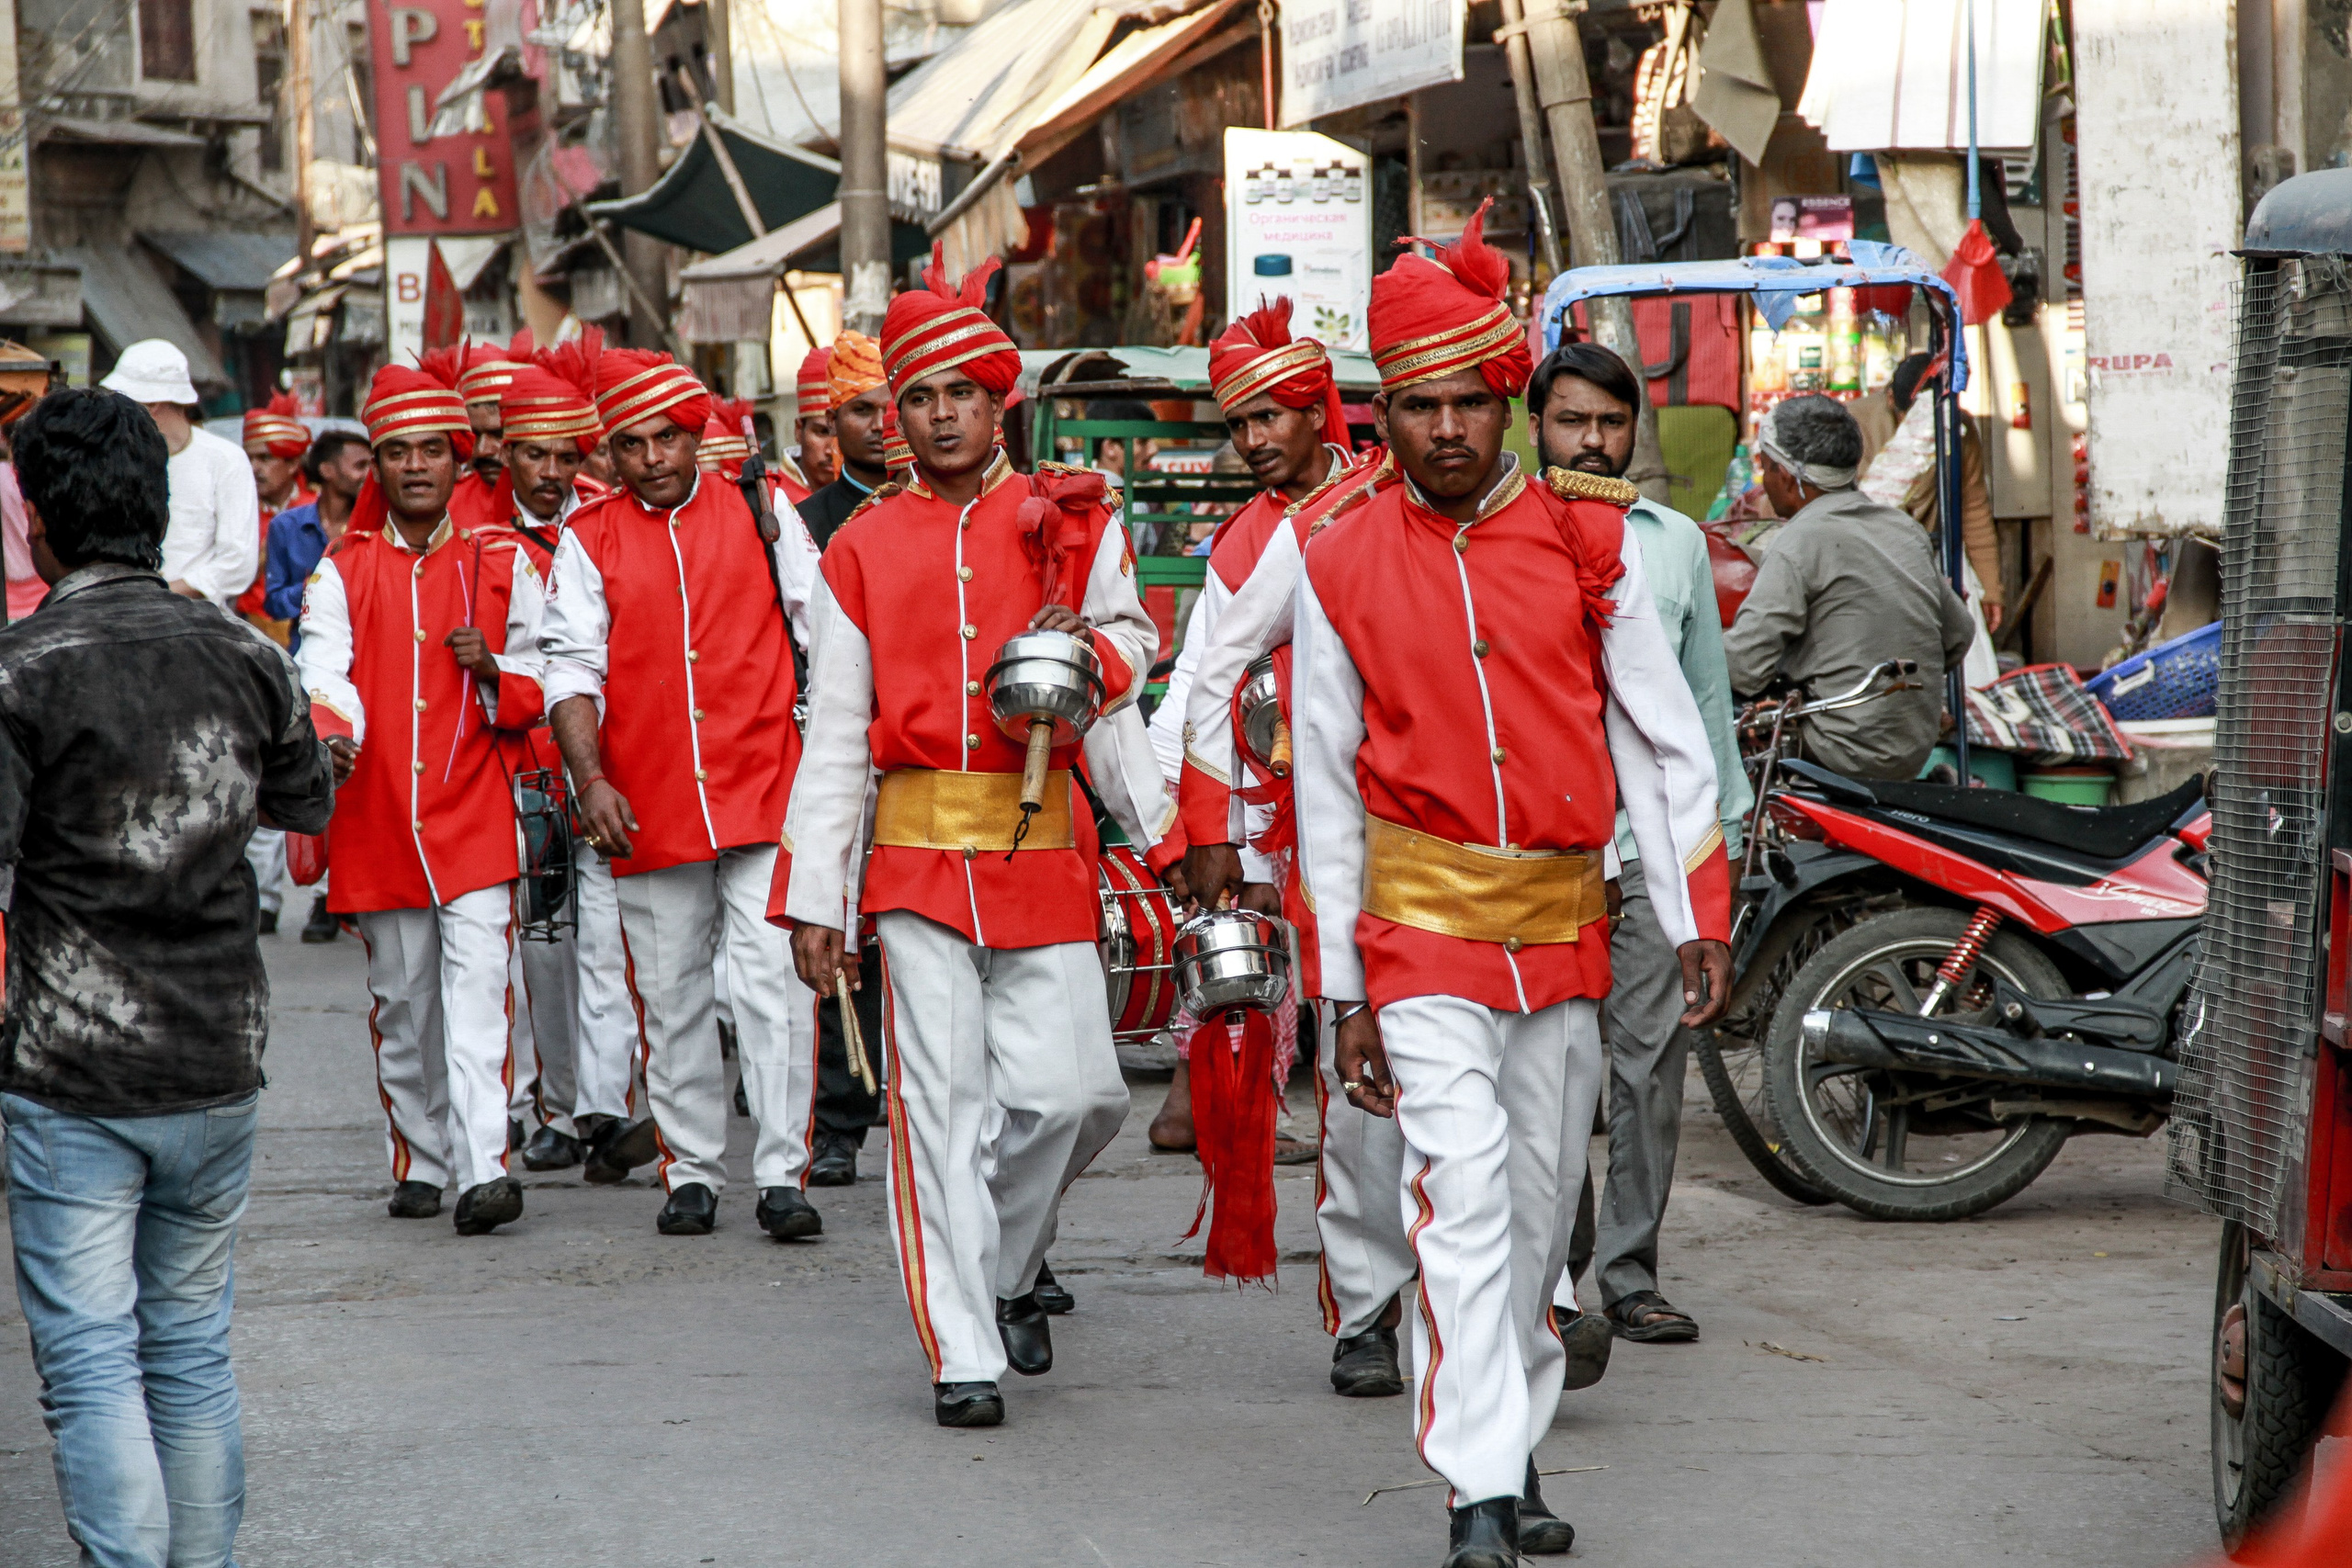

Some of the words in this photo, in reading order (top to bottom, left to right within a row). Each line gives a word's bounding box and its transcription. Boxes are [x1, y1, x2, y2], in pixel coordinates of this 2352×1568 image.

[1249, 212, 1348, 227] Органическая
[1263, 231, 1334, 243] медицина
[2088, 353, 2174, 371] RUPA
